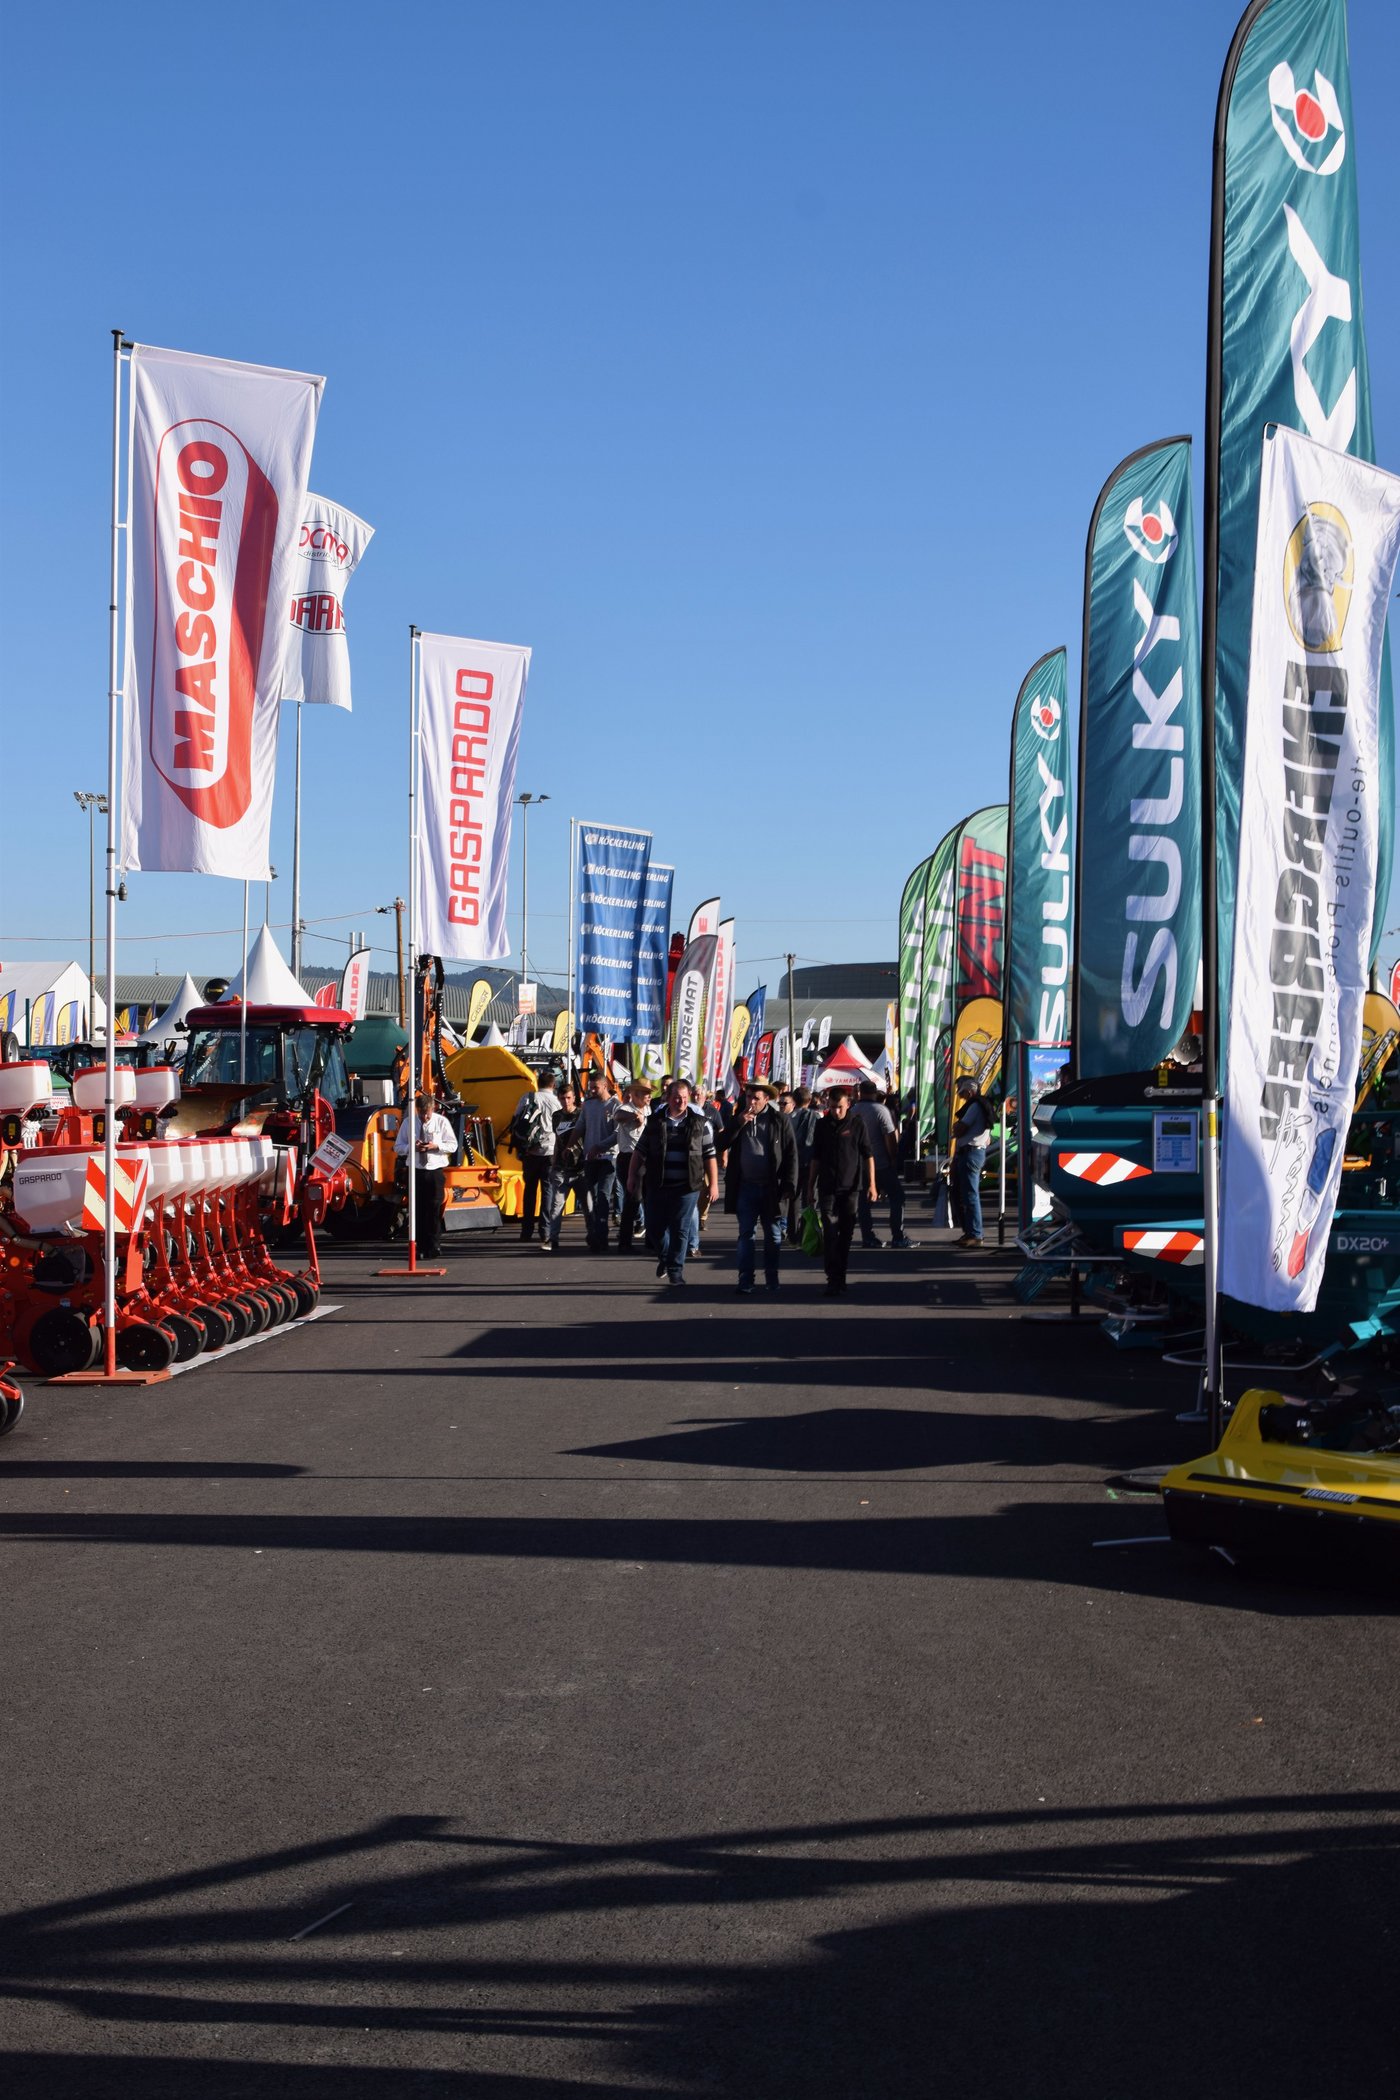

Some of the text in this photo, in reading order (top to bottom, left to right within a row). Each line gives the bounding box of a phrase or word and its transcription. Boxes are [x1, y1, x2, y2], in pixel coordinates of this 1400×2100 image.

[174, 440, 229, 772] MASCHIO
[448, 668, 494, 926] GASPARDO
[1120, 578, 1184, 1030] SULKY
[598, 834, 646, 851] KÖCKERLING
[594, 864, 641, 881] KÖCKERLING
[594, 893, 638, 909] KÖCKERLING
[1036, 752, 1069, 1048] SULKY
[957, 835, 1005, 999] VANT
[592, 925, 635, 940] KÖCKERLING
[590, 955, 633, 970] KÖCKERLING
[588, 984, 632, 999] KÖCKERLING
[585, 1014, 632, 1027] KÖCKERLING
[680, 976, 699, 1061] NOREMAT
[977, 1040, 1003, 1085] GRISE
[19, 1172, 62, 1185] GASPARDO
[1337, 1236, 1389, 1251] DX20+
